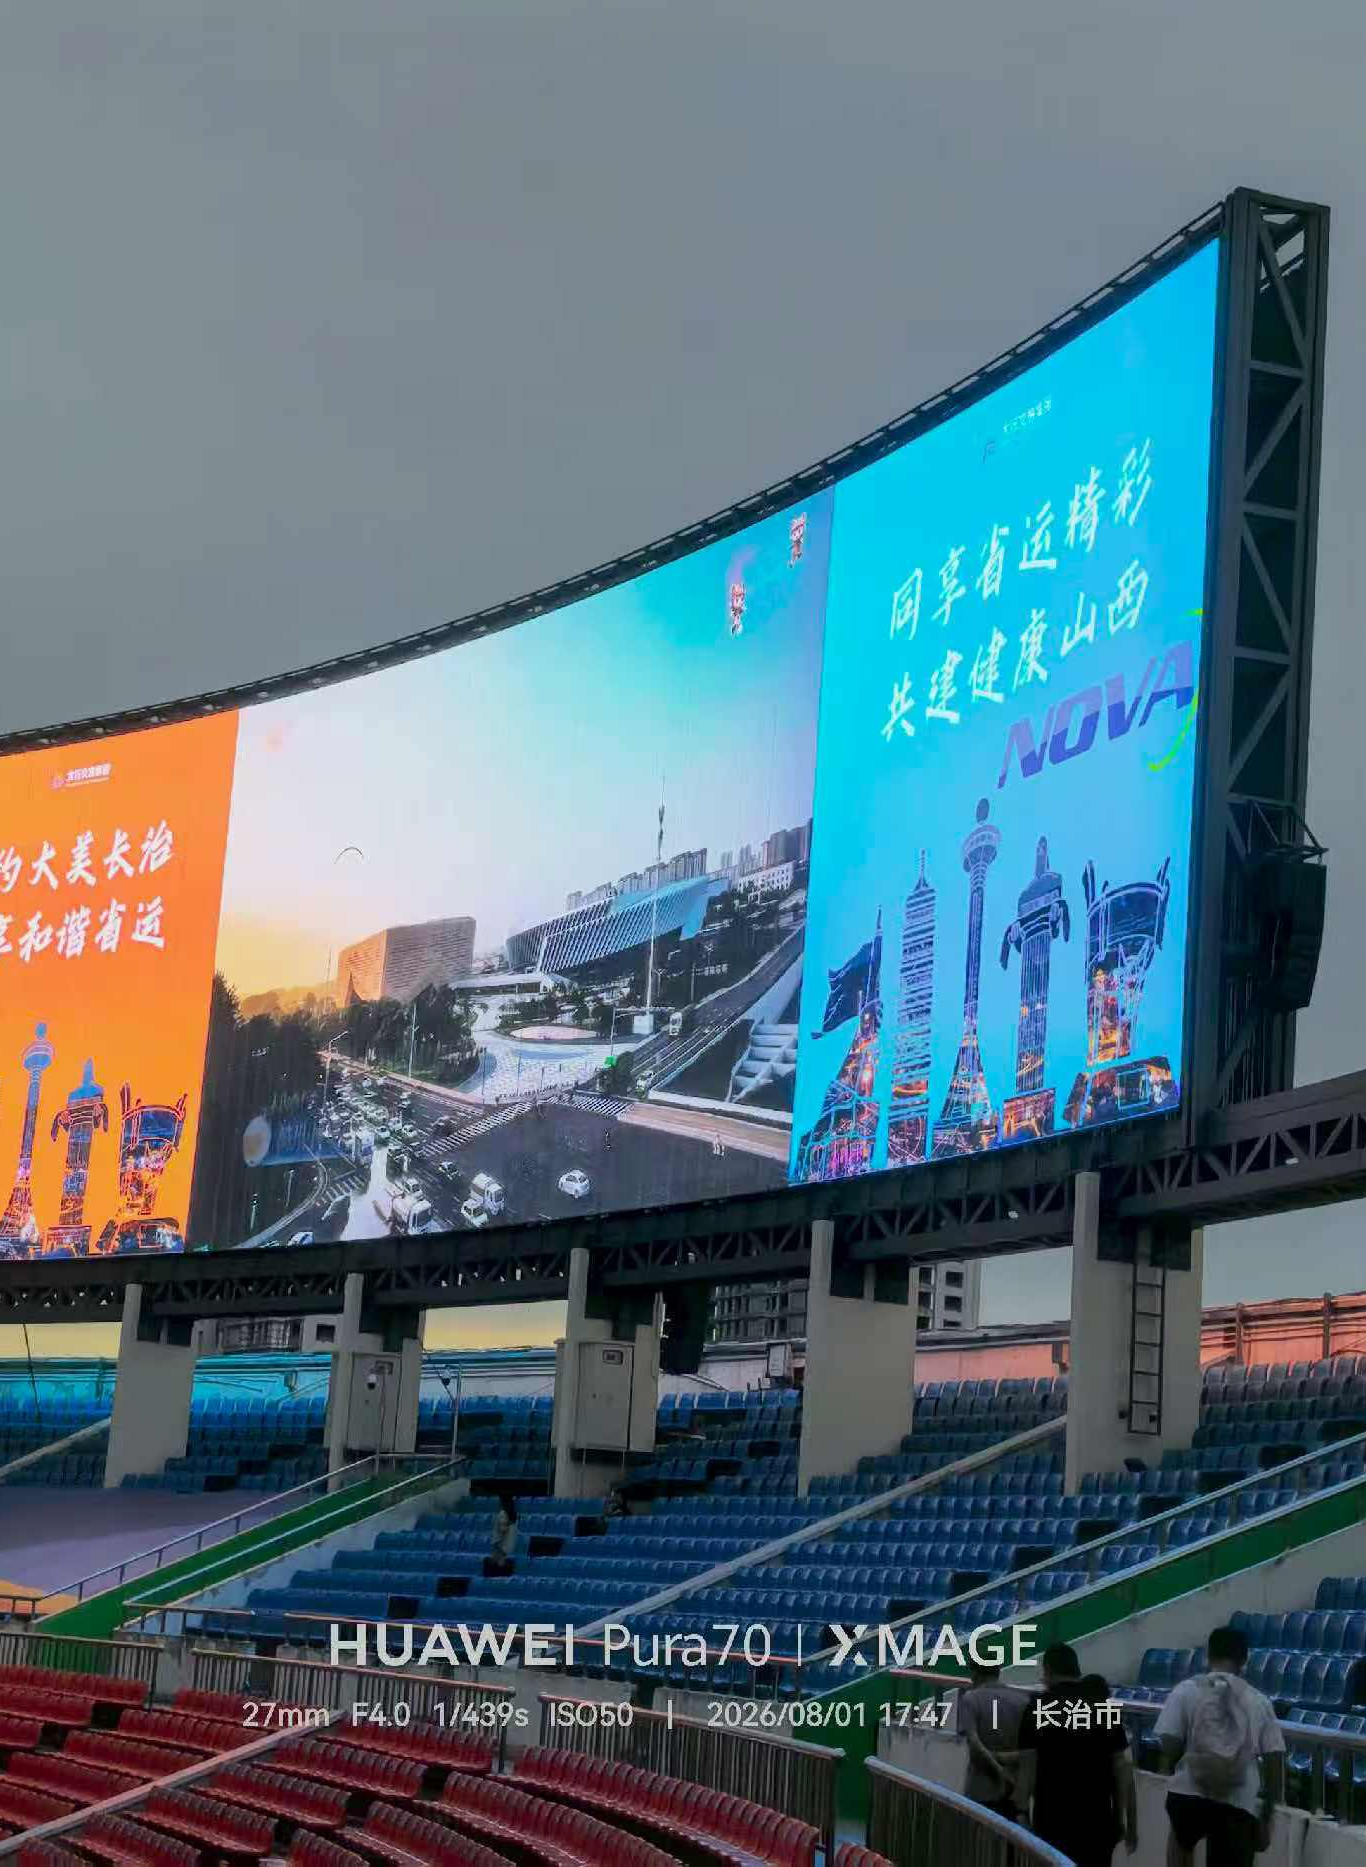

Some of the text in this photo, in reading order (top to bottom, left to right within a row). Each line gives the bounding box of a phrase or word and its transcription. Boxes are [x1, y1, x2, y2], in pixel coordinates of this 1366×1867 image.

[889, 437, 1153, 641] 同享省运精彩
[880, 560, 1150, 742] 共建健康山西
[996, 639, 1195, 790] NOVA
